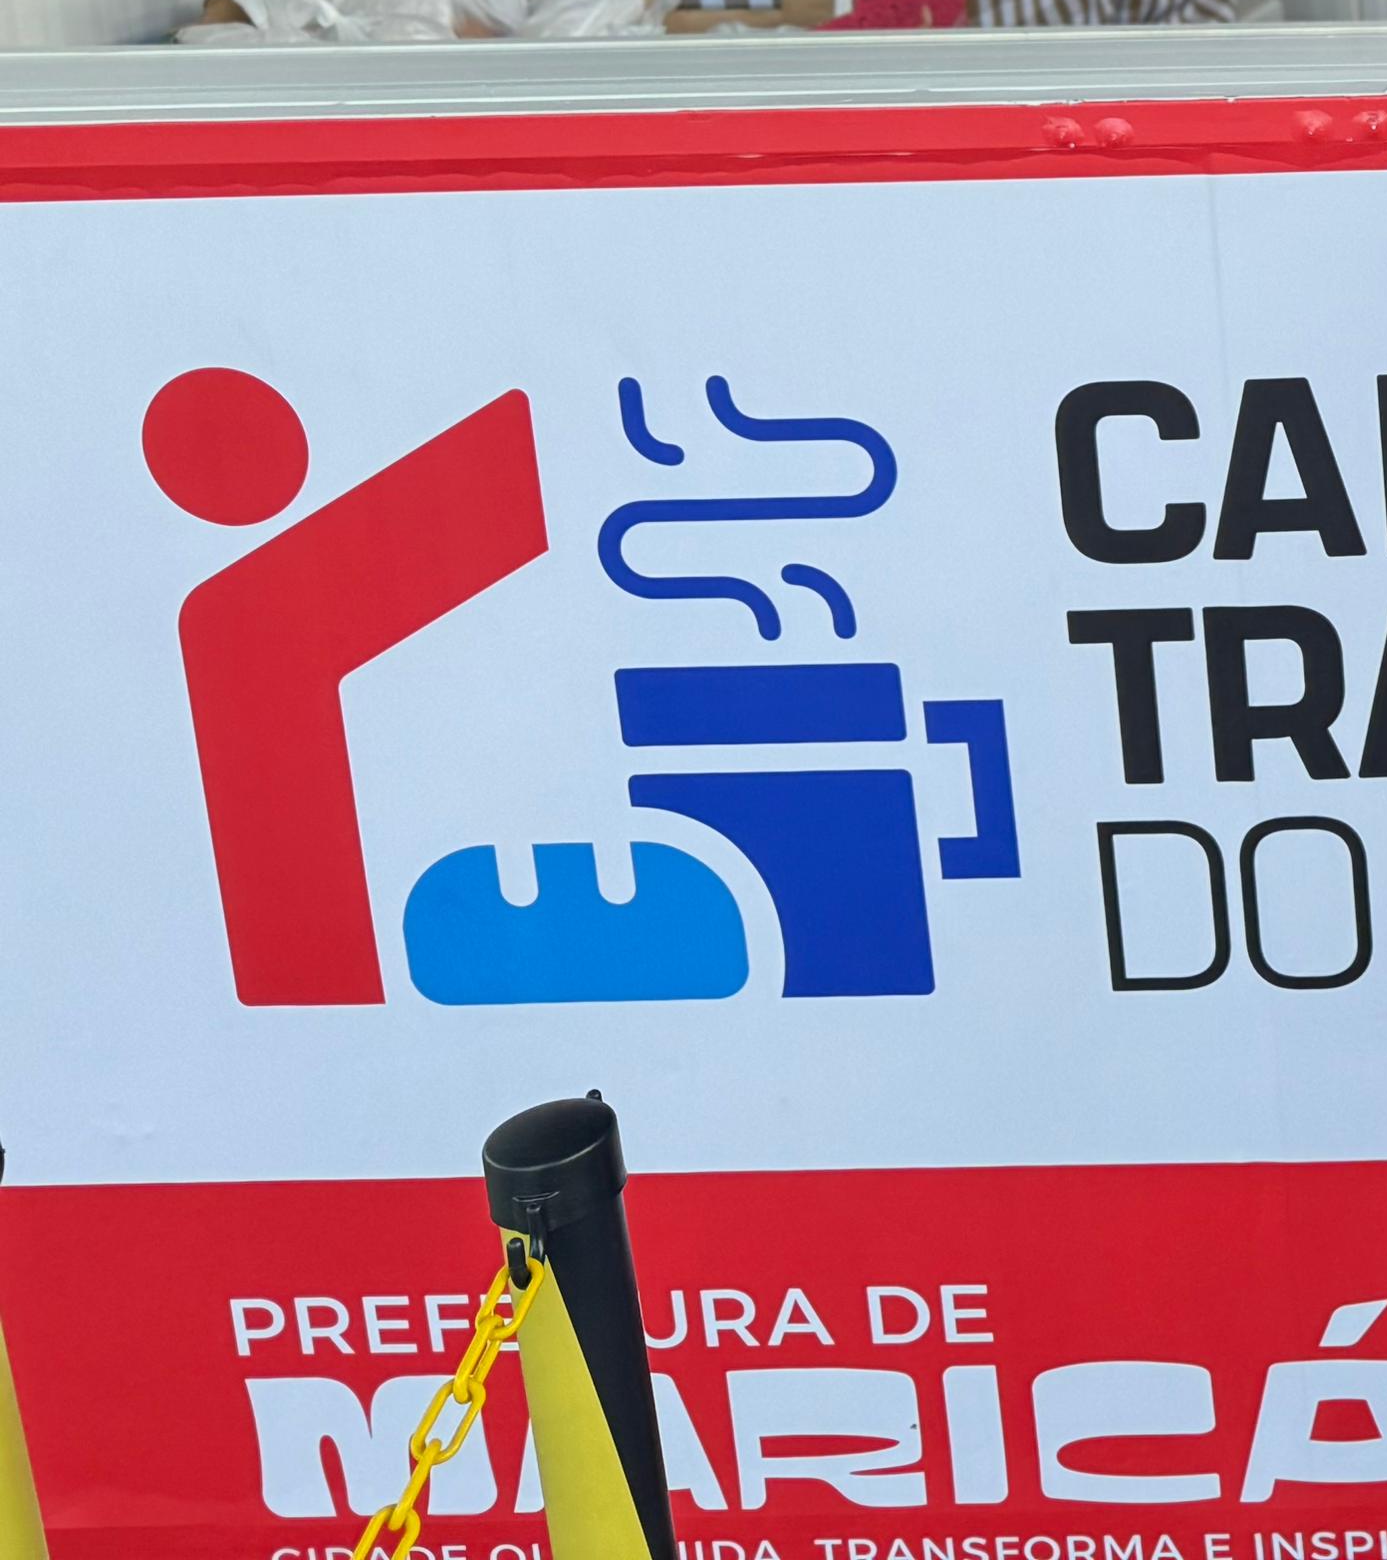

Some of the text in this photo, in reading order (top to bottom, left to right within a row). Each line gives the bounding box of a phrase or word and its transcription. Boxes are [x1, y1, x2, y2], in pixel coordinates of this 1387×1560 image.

[1097, 816, 1373, 992] DO
[230, 1284, 995, 1357] PREFURA DE
